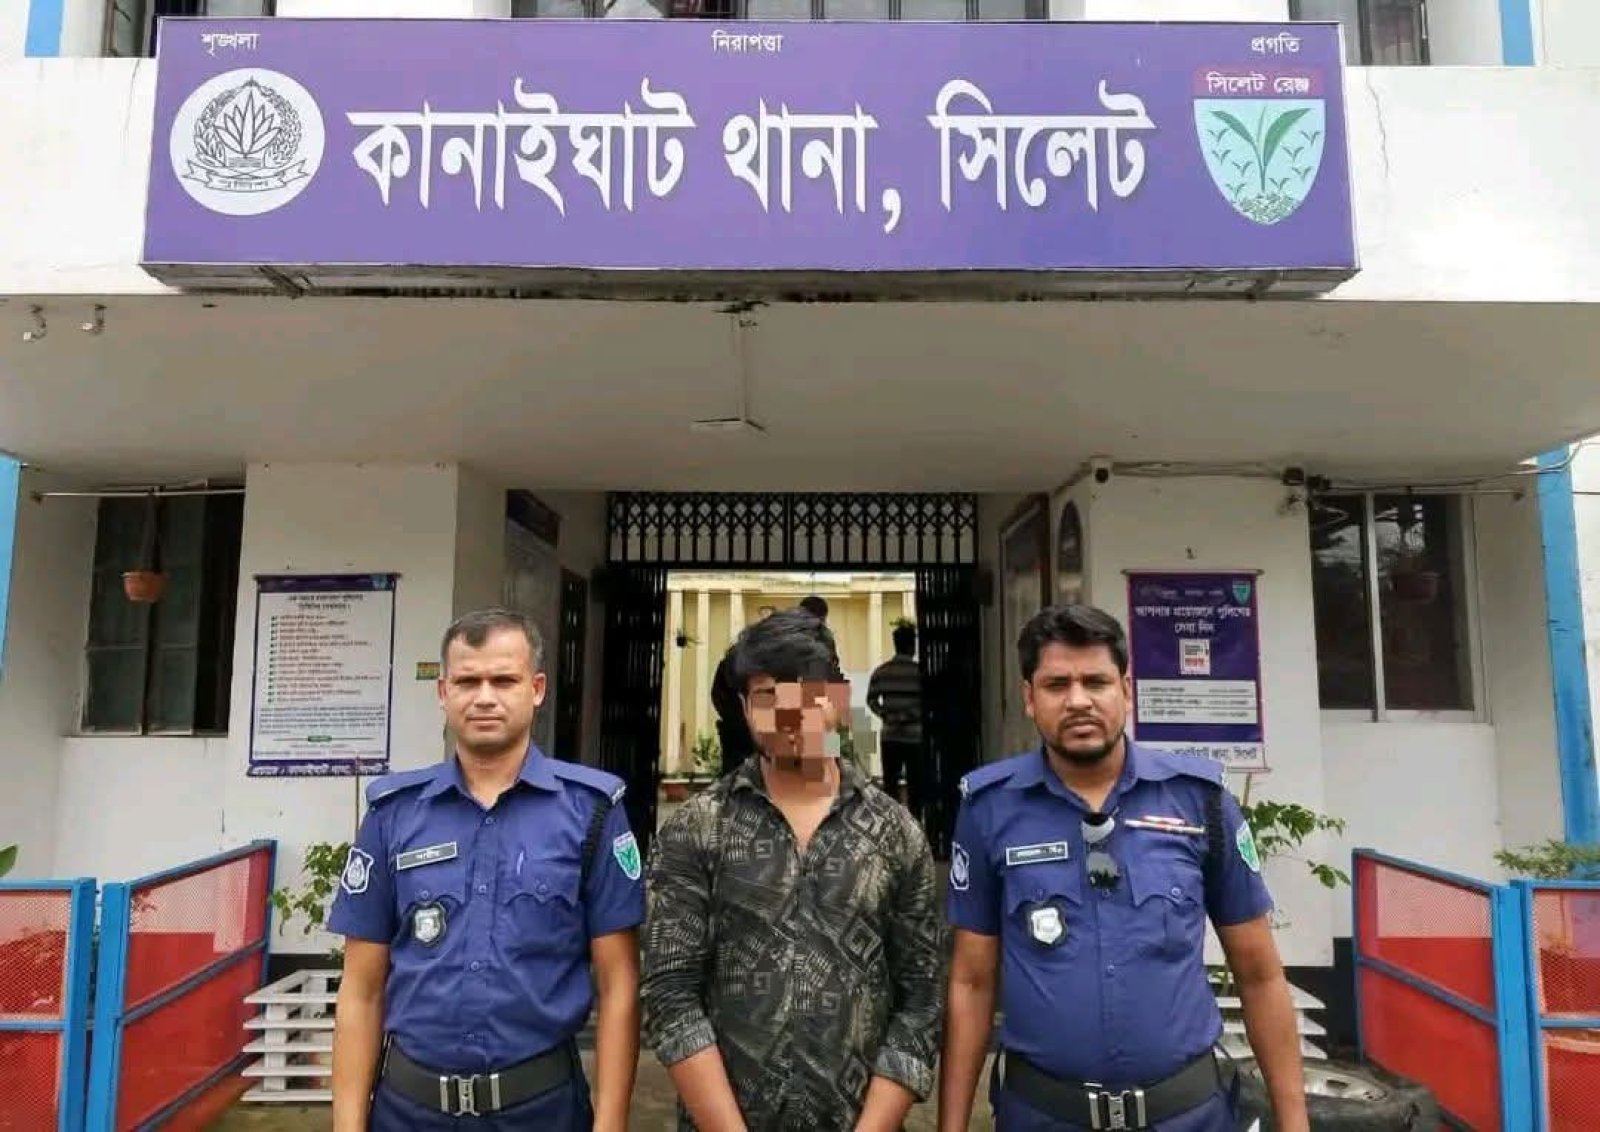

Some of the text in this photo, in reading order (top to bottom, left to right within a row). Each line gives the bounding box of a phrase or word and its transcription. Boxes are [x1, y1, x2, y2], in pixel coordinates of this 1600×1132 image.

[200, 33, 261, 56] শৃঙ্খলা
[711, 29, 784, 52] নিরাপত্তা
[1251, 32, 1301, 54] প্রগতি
[1207, 71, 1266, 93] সিলেট
[346, 77, 1155, 233] কানাইঘাট থানা, সিলেট
